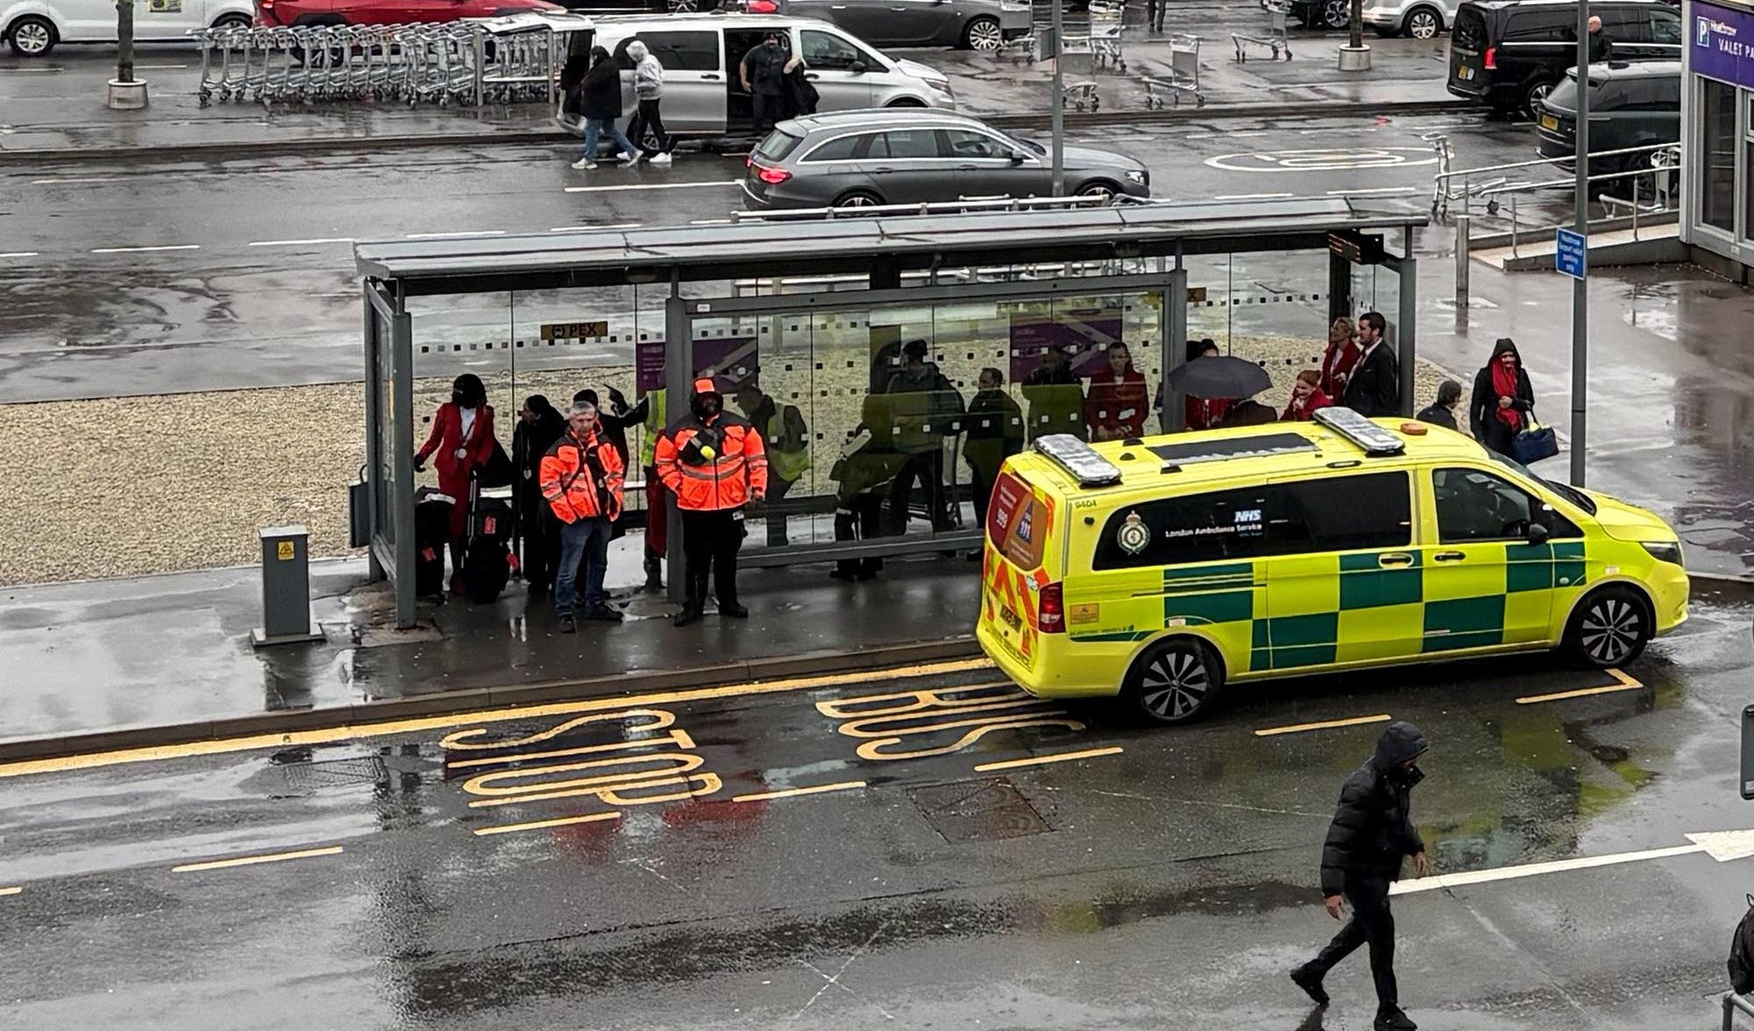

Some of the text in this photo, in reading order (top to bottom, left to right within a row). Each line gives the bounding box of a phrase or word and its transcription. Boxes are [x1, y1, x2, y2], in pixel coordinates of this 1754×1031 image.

[1718, 38, 1742, 56] VALET
[1234, 510, 1262, 523] NHS
[1165, 529, 1194, 538] London
[1195, 526, 1235, 536] Ambulance
[815, 680, 1087, 761] BUS
[439, 709, 723, 809] STOP
